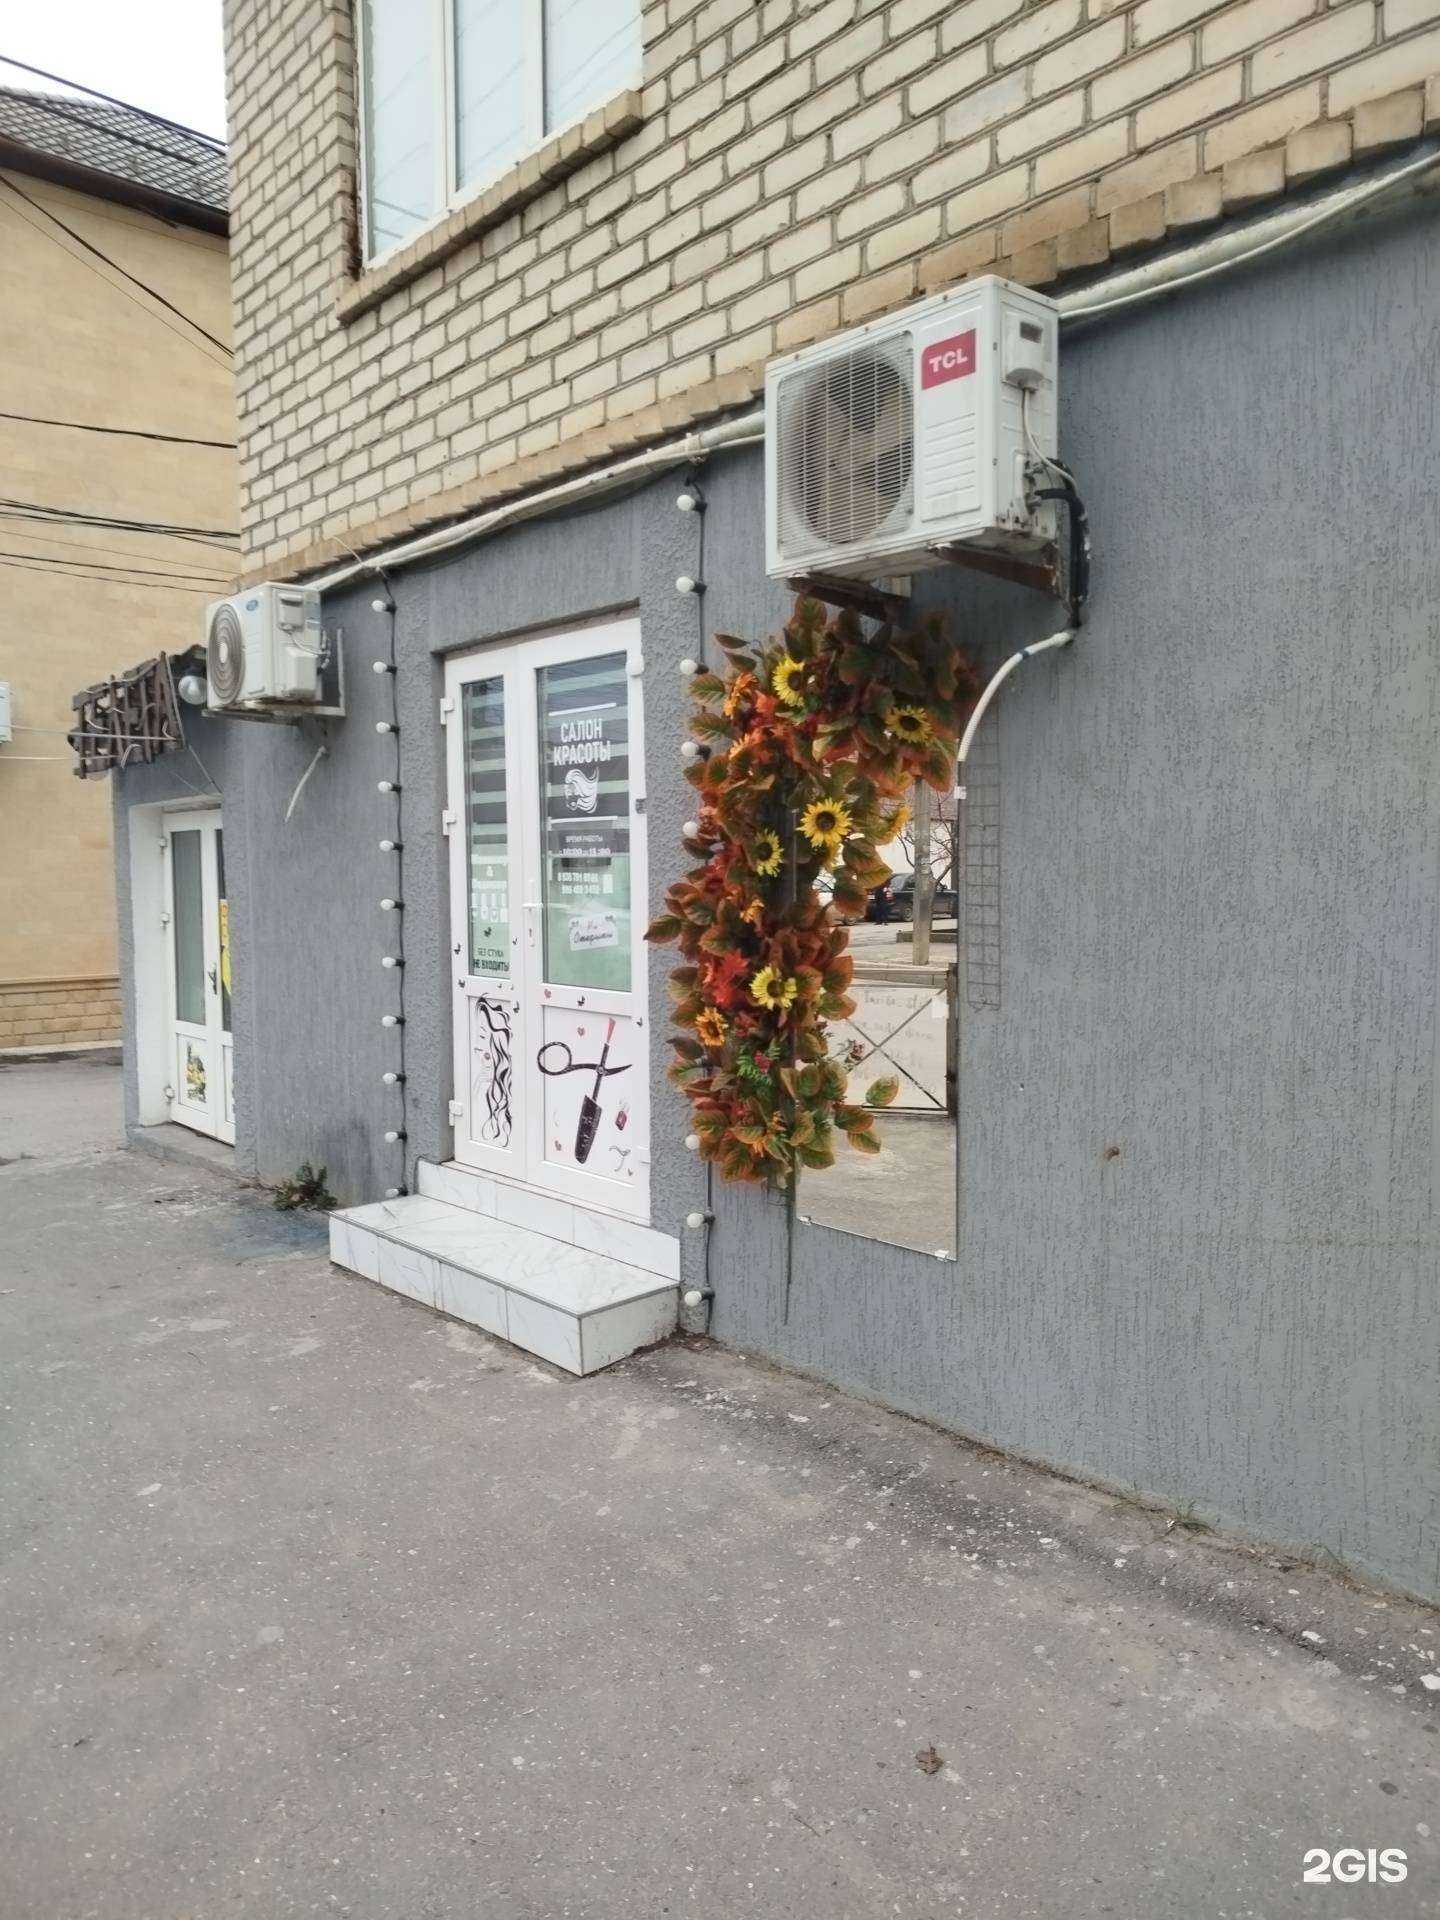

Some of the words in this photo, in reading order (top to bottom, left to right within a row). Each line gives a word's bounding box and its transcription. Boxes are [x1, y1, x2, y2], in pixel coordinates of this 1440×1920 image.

[929, 348, 967, 373] TCL
[560, 718, 603, 743] САЛОН
[553, 740, 611, 766] КРАСОТЫ
[472, 959, 481, 969] НЕ
